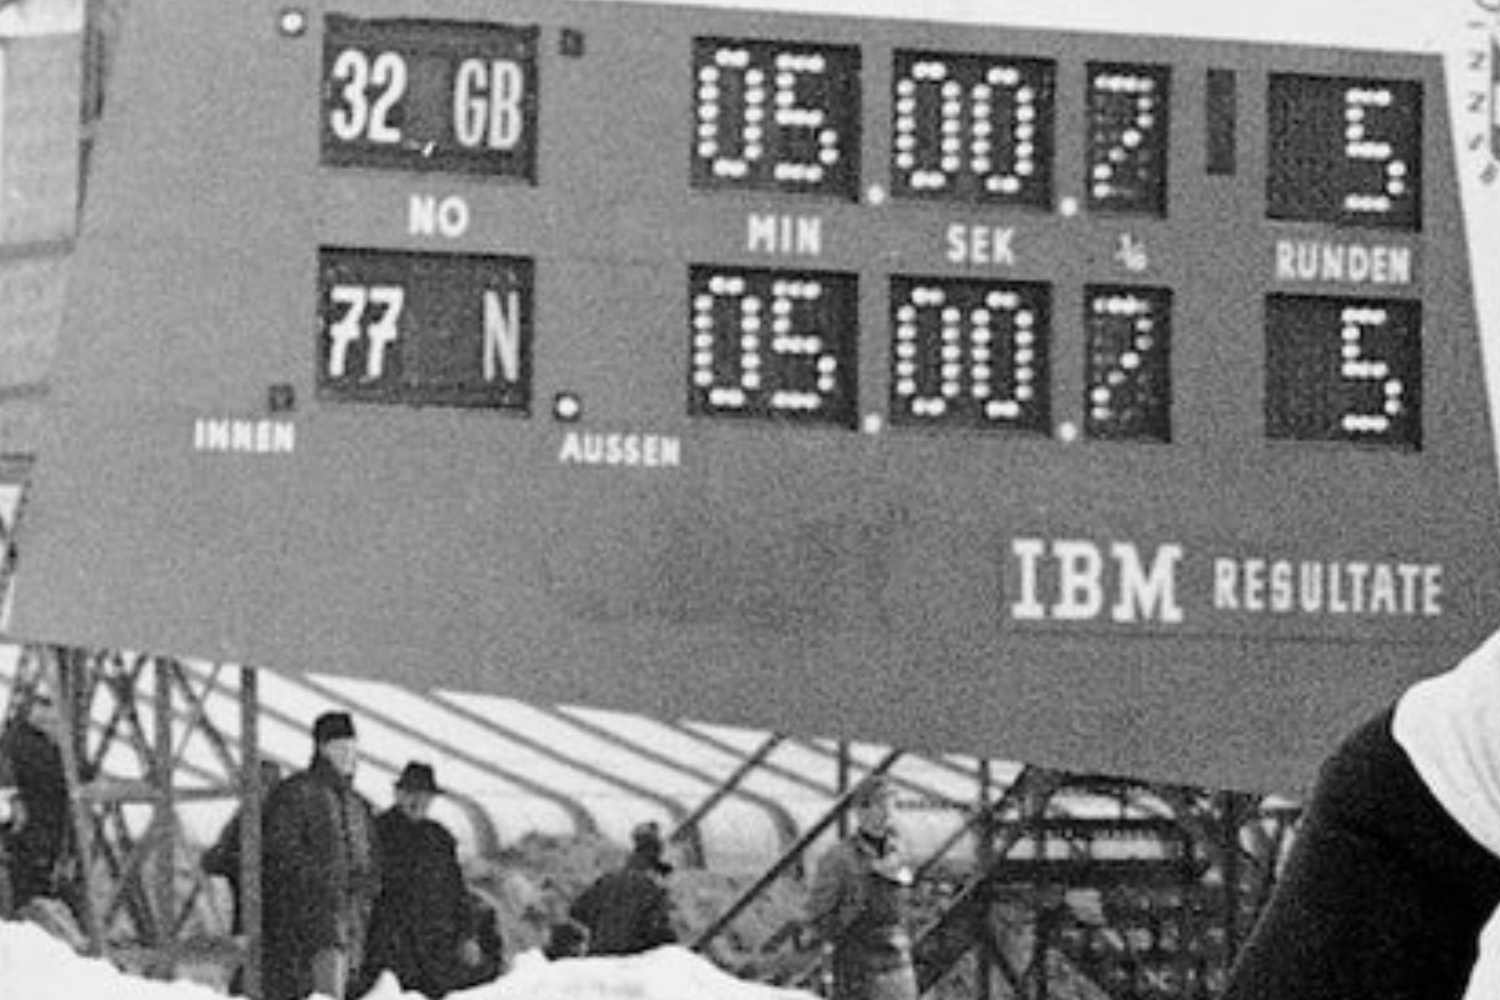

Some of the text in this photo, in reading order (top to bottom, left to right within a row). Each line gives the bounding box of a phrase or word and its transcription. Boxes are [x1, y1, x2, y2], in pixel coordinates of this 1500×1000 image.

[330, 49, 524, 150] 32 GB
[1343, 87, 1407, 213] 5
[407, 194, 470, 238] NO
[746, 213, 822, 256] MIN
[946, 223, 1015, 266] SEK
[1275, 239, 1411, 285] RUNDEN
[328, 284, 520, 382] 77 N
[1340, 306, 1403, 433] 5
[193, 418, 296, 454] INNEN
[558, 431, 681, 468] AUSSEN
[1011, 538, 1443, 624] IBM RESULTATE
